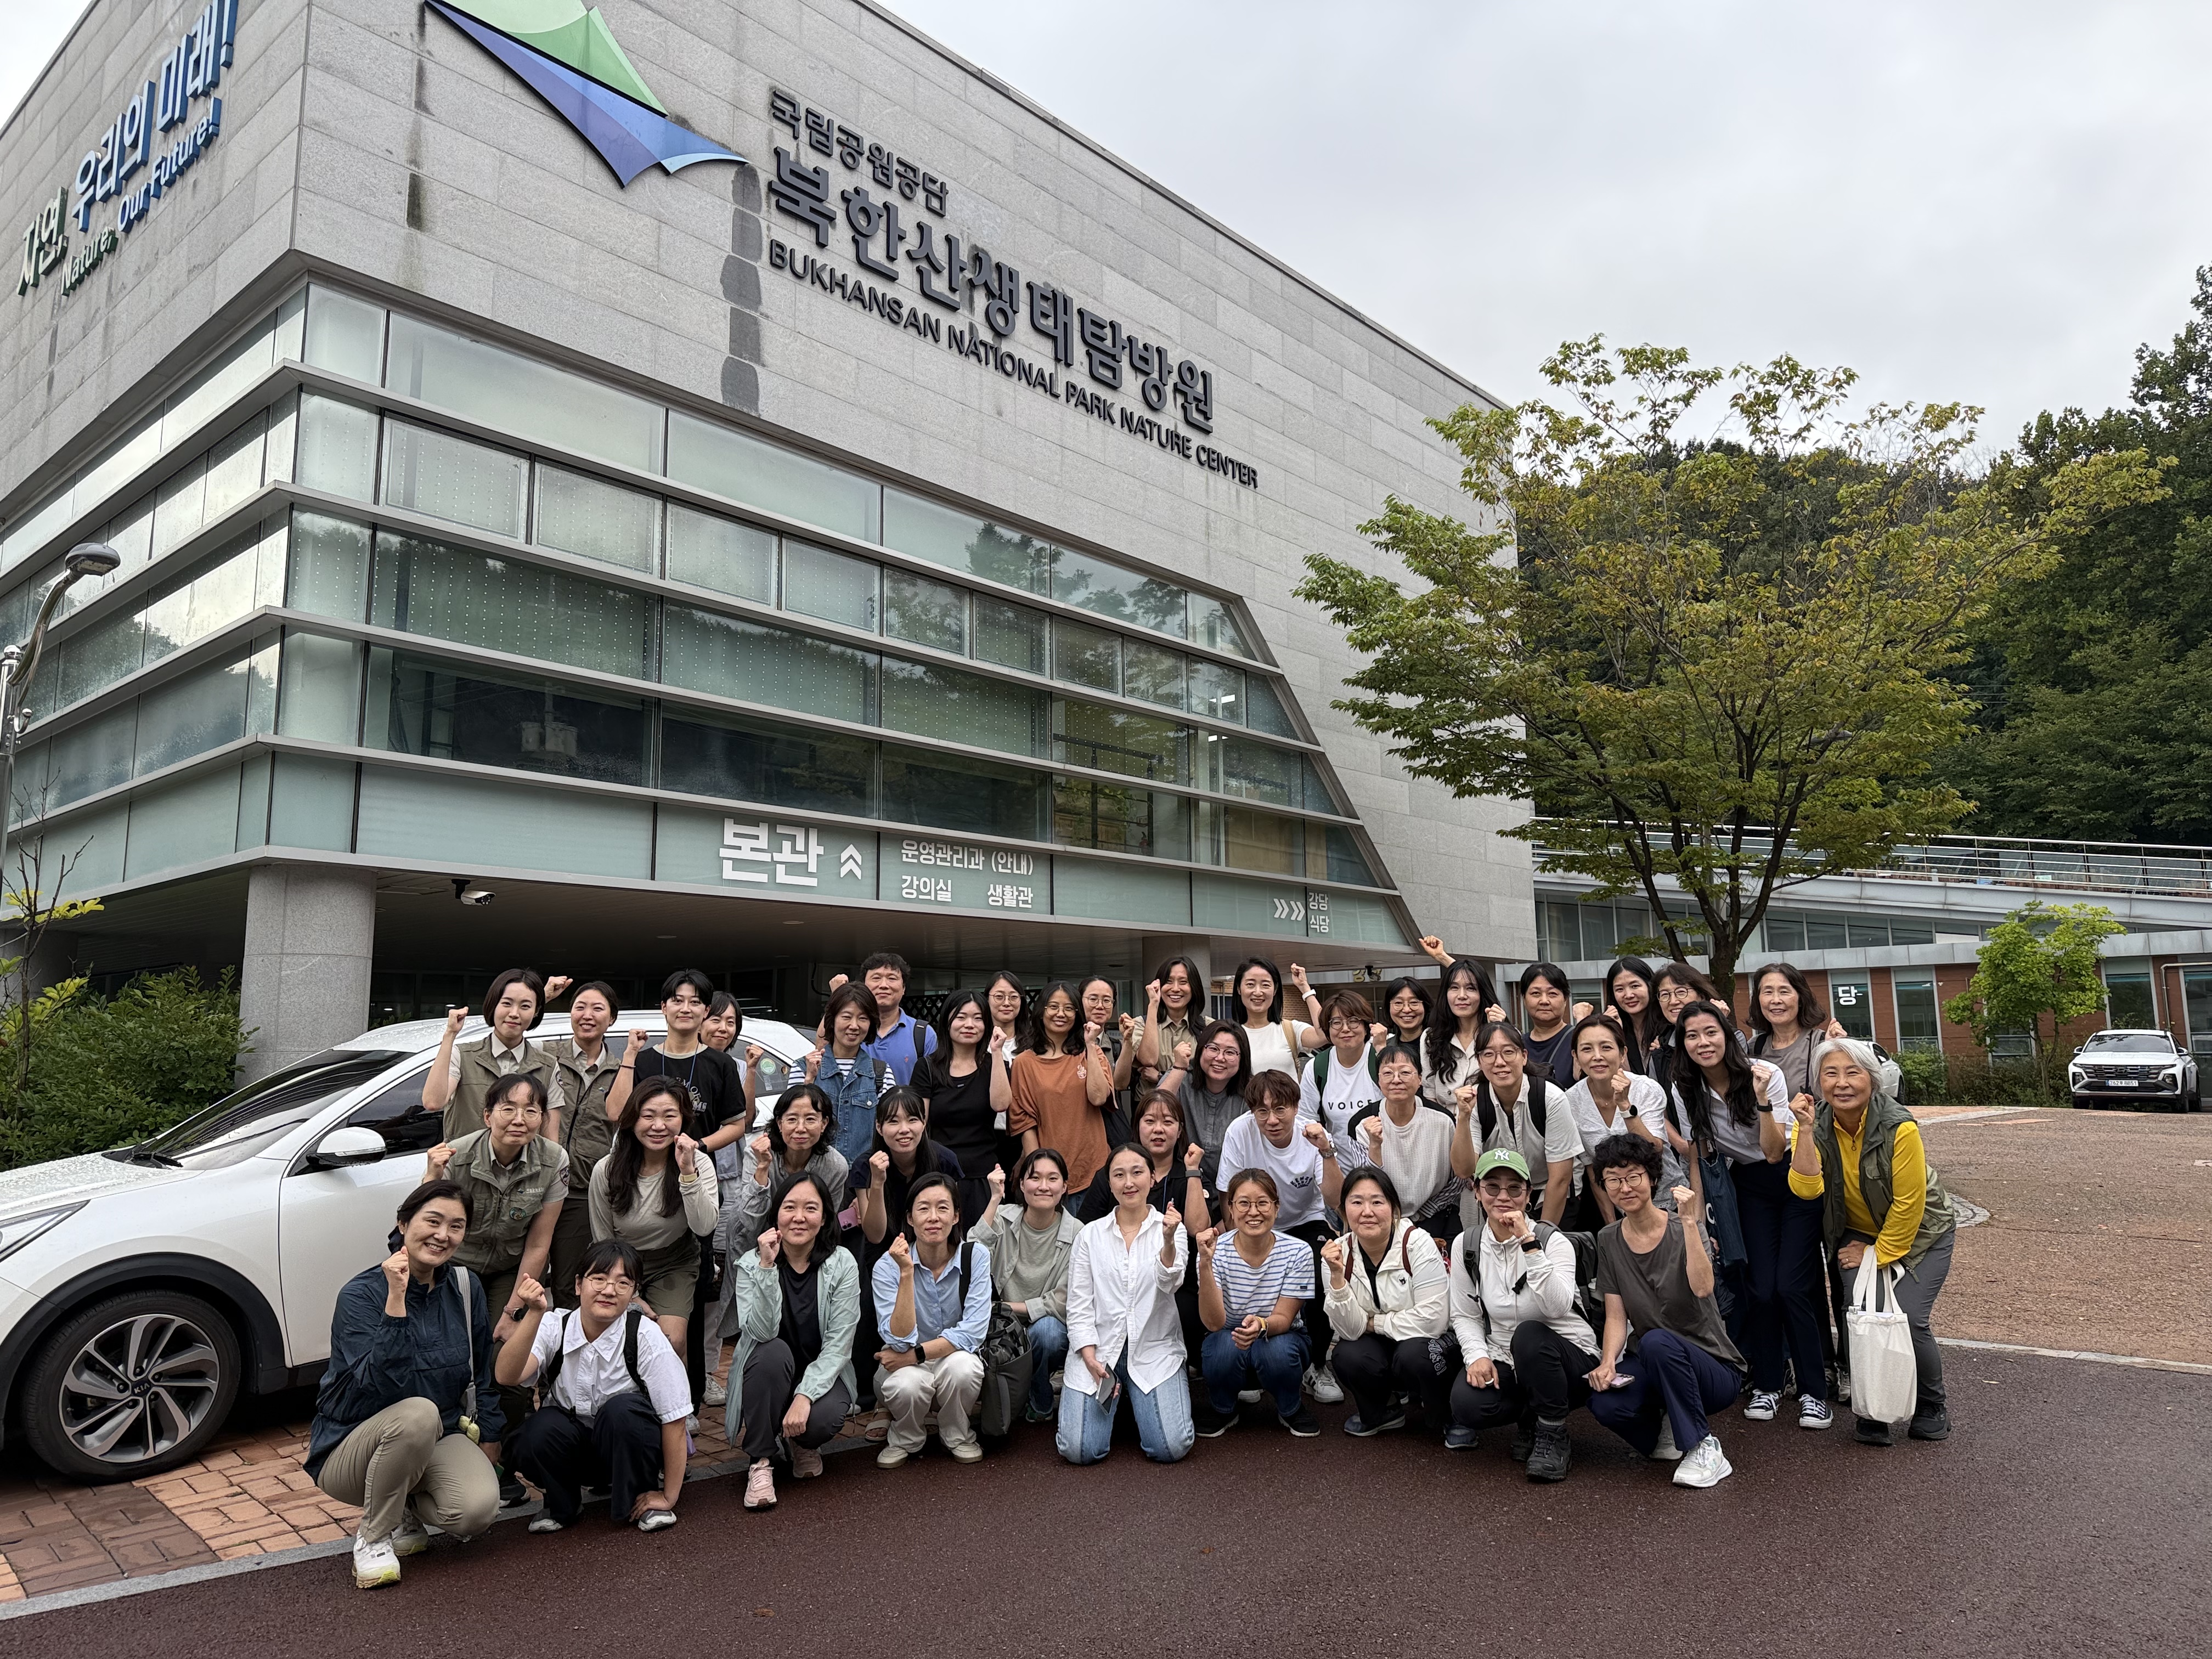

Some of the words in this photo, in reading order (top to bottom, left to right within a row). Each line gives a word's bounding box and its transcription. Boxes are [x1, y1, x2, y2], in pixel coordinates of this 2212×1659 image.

[72, 80, 156, 233] 우리의
[772, 90, 949, 217] 국립공원공단
[61, 226, 119, 297] Nature,
[117, 182, 151, 233] Our
[150, 97, 222, 199] Future!
[769, 147, 1214, 433] 북한산생태탐방원
[770, 239, 941, 342] BUKHANSAN
[948, 324, 1060, 398] NATIONAL
[1066, 381, 1115, 425] PARK
[1121, 407, 1192, 458] NATURE
[1196, 444, 1259, 488] CENTER
[719, 817, 824, 887] 본관
[901, 839, 985, 871] 운영관리과
[991, 850, 1034, 876] (안내)
[901, 874, 952, 903] 강의실
[987, 883, 1033, 909] 생활관
[1308, 892, 1329, 911] 강당
[1310, 915, 1330, 933] 식당
[1494, 1150, 1510, 1161] NY
[134, 1383, 150, 1393] KIA
